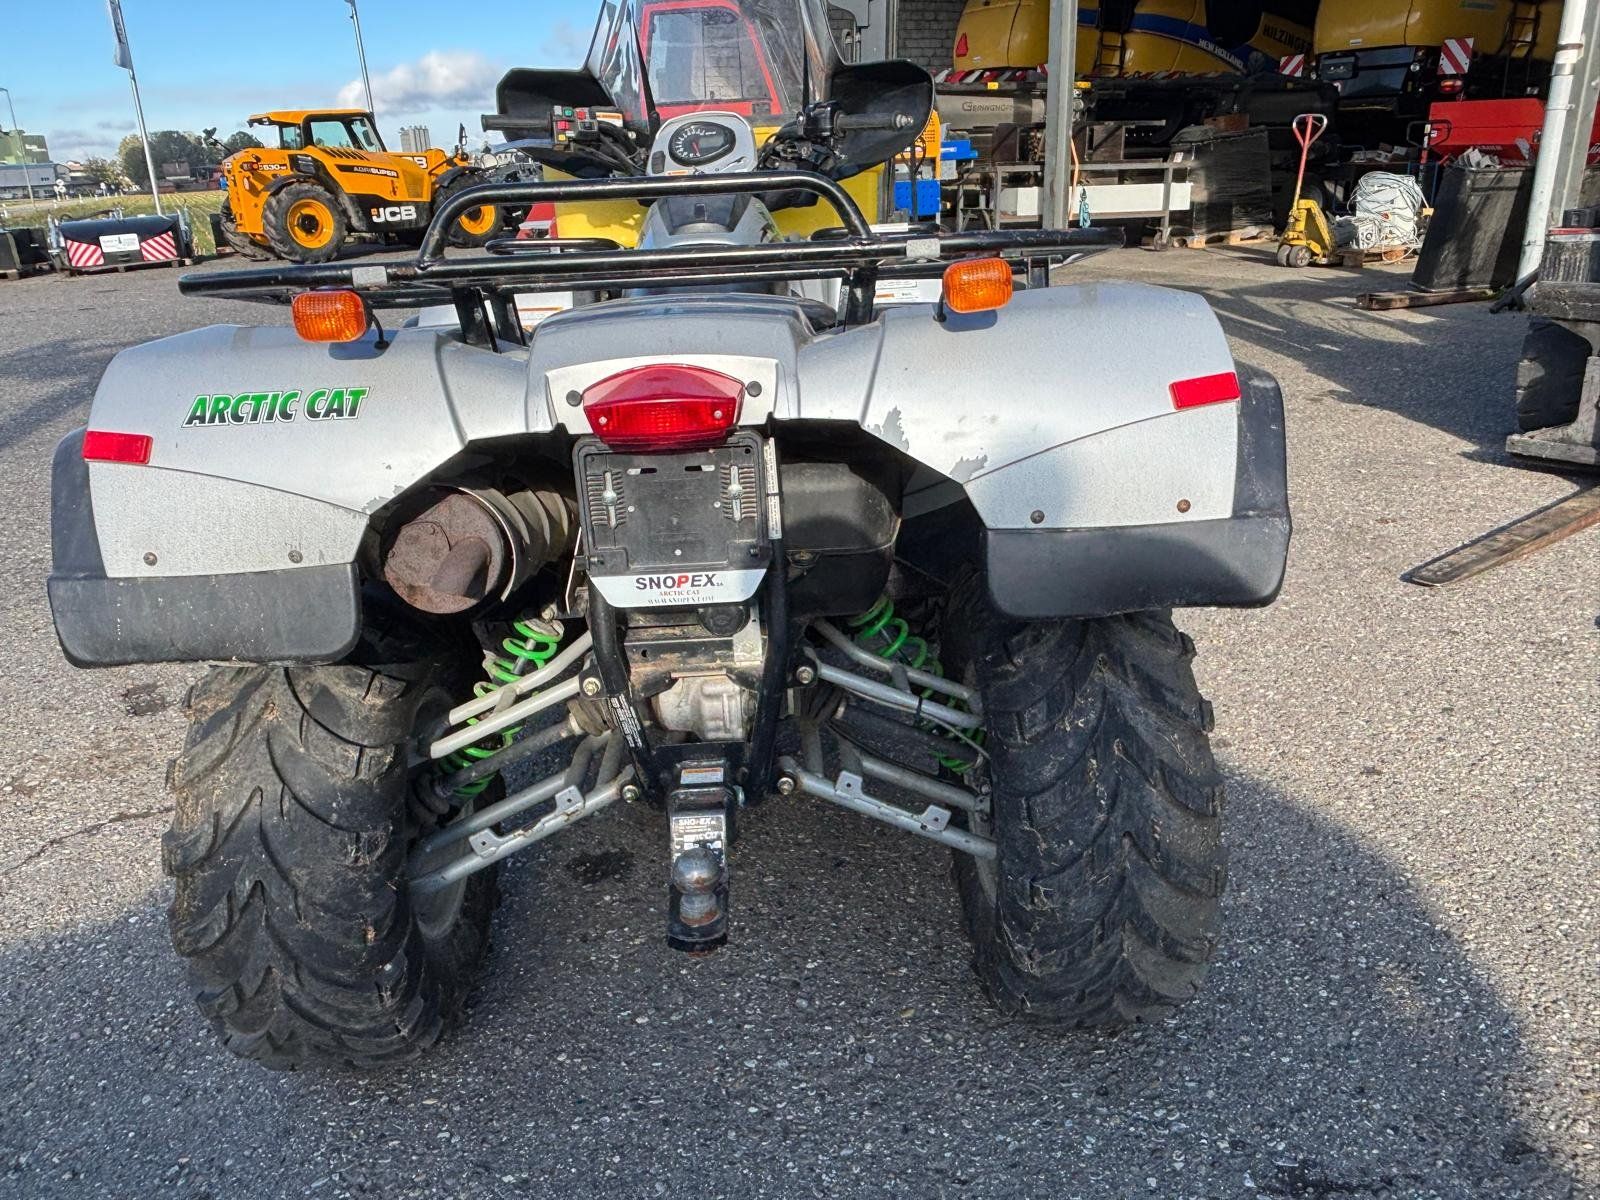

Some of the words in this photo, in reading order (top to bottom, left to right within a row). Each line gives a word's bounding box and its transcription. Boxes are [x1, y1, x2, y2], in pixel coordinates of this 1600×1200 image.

[1199, 38, 1215, 50] NEW
[1215, 45, 1244, 69] HOLLAND
[371, 205, 417, 223] JCB
[181, 390, 302, 428] ARCTIC
[303, 387, 370, 421] CAT
[636, 573, 717, 590] SNOPEX
[686, 588, 700, 596] CAT
